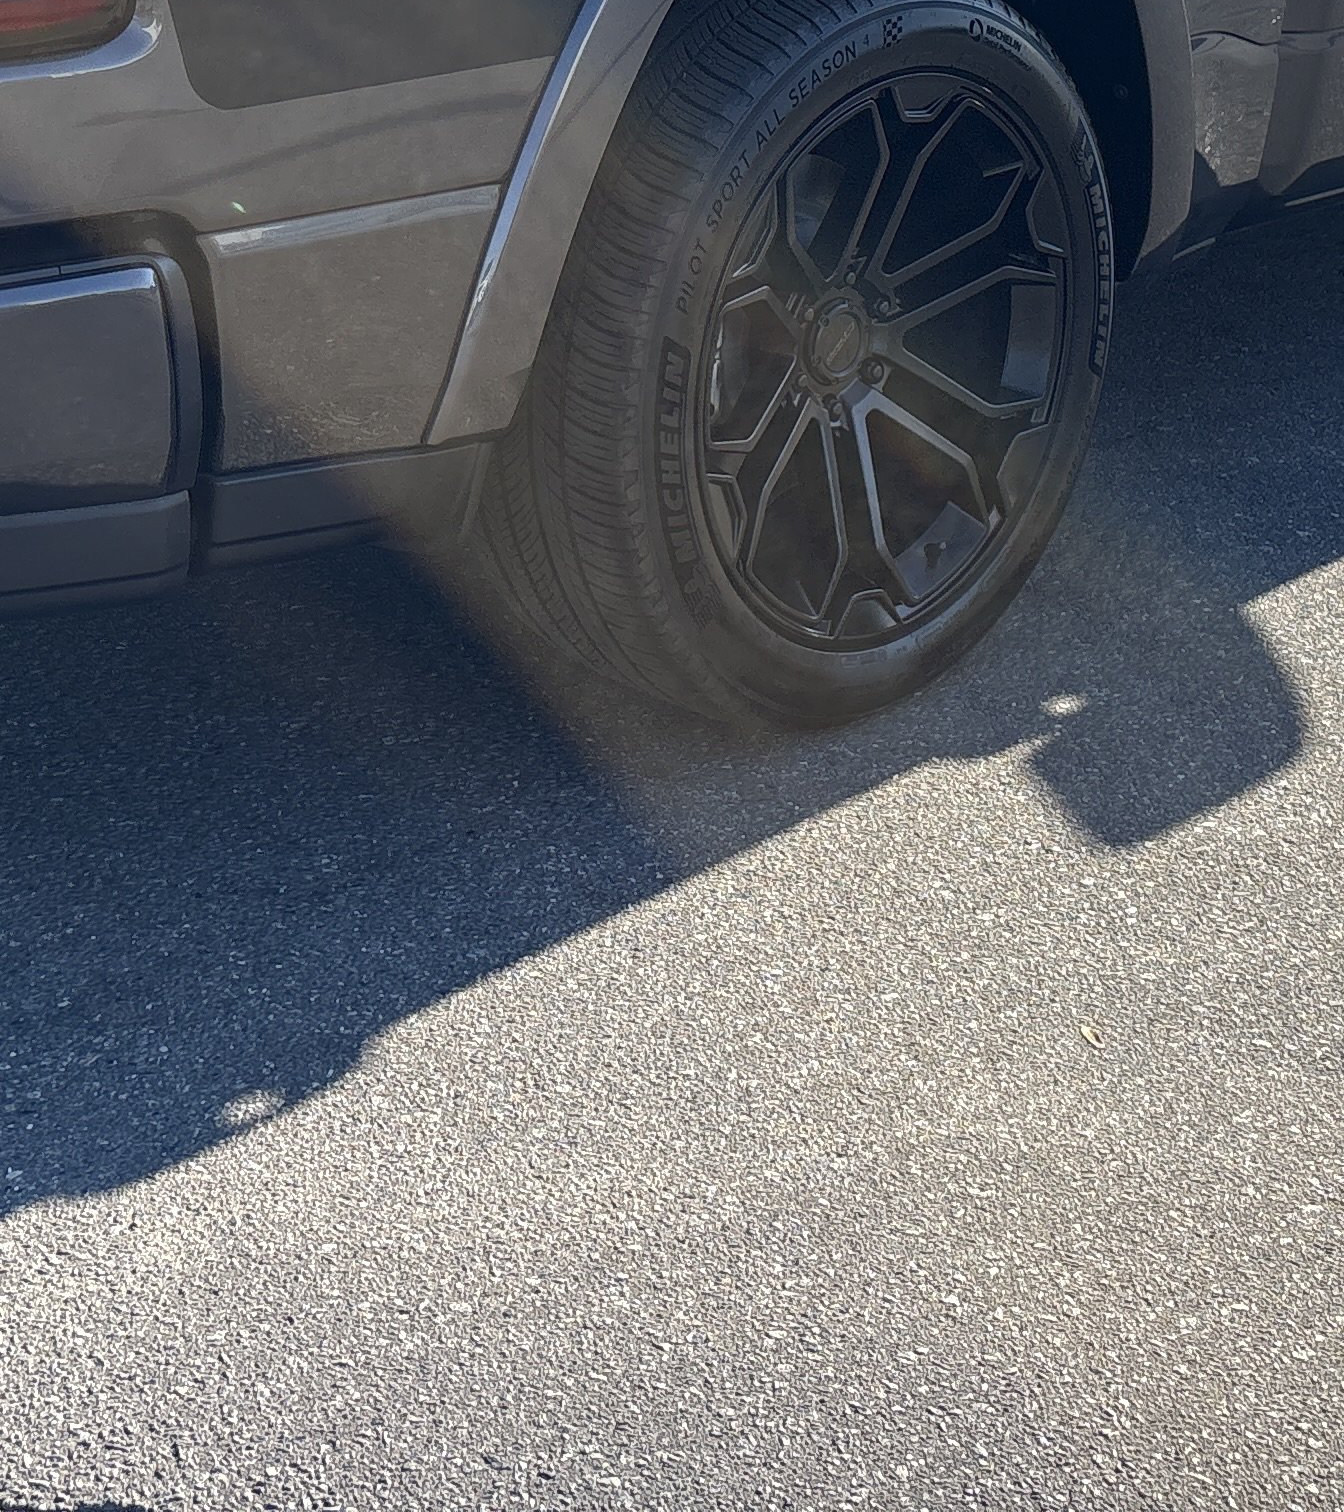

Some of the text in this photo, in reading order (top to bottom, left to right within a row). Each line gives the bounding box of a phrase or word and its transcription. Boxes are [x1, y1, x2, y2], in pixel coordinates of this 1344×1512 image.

[985, 24, 1023, 53] MICHELIN
[675, 239, 707, 315] PILOT
[705, 148, 751, 234] SPORT
[755, 108, 786, 153] ALL
[787, 40, 857, 109] SEASON
[1089, 183, 1111, 368] MICHELIN
[658, 351, 699, 564] MICHELIN
